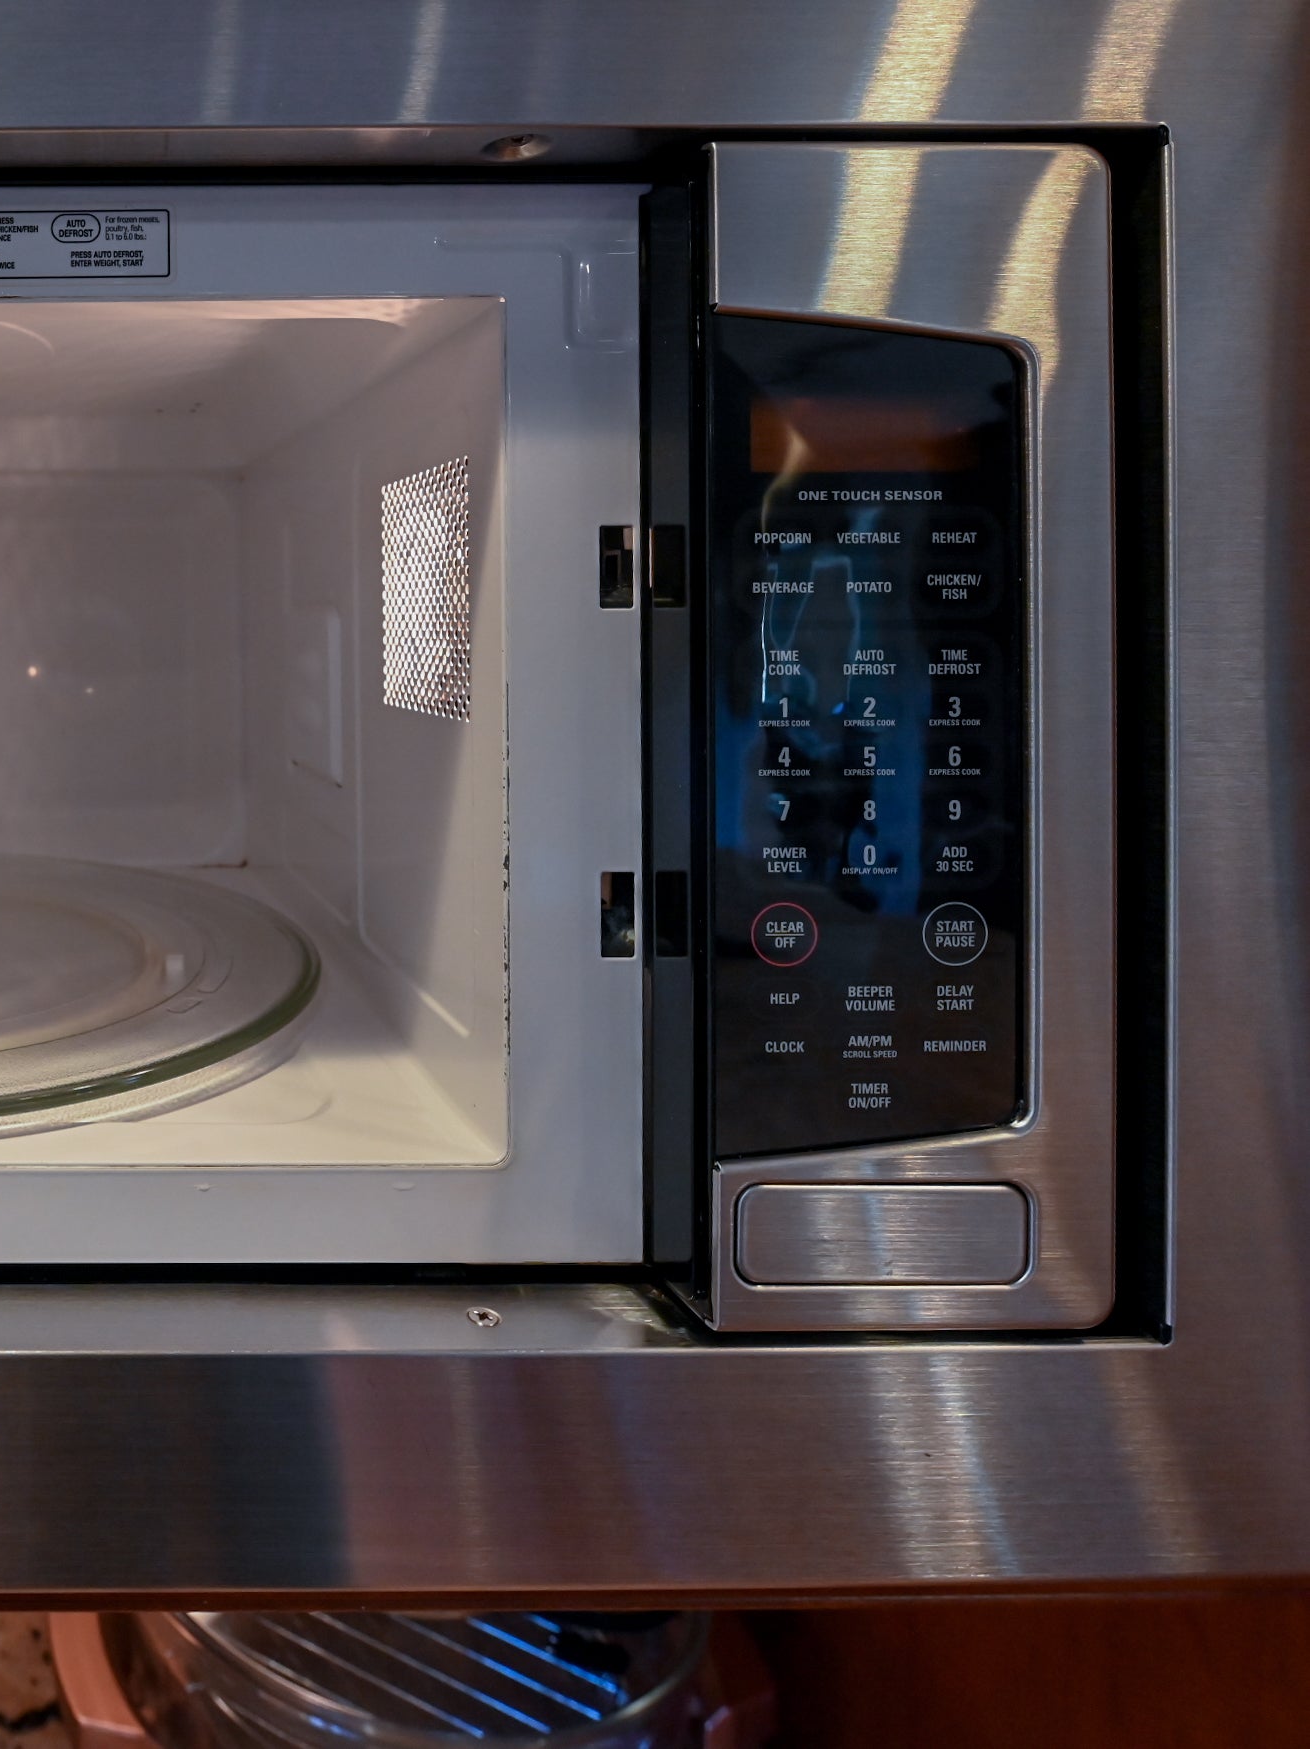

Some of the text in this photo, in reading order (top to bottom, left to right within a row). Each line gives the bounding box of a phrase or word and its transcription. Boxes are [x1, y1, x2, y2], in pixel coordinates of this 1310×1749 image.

[59, 229, 93, 237] DEFROST
[106, 224, 128, 232] poultry,
[113, 250, 144, 258] DEFROST,
[798, 490, 942, 501] ONE TOUCH SENSOR
[754, 533, 811, 544] POPCORN
[837, 533, 900, 544] VEGETABLE
[932, 532, 977, 543] REHEAT
[927, 574, 981, 586] CHICKEN/
[752, 582, 814, 593] BEVERAGE
[846, 582, 891, 593] POTATO
[942, 589, 967, 600] FISH
[770, 651, 799, 661] TIME
[855, 650, 884, 661] AUTO
[941, 650, 967, 660] TIME
[769, 665, 801, 675] COOK
[843, 664, 896, 675] DEFROST
[928, 664, 981, 675] DEFROST
[779, 697, 788, 718] 1
[863, 697, 876, 718] 2
[948, 697, 961, 717] 3
[778, 747, 791, 767] 4
[863, 747, 876, 767] 5
[948, 746, 961, 767] 6
[759, 769, 810, 777] EXPRESS COOK
[778, 801, 790, 821] 7
[863, 800, 876, 820] 8
[948, 800, 961, 820] 9
[763, 848, 807, 858] POWER
[864, 845, 876, 866] 0
[942, 847, 967, 858] ADD
[768, 862, 802, 873] LEVEL
[873, 867, 898, 875] ON/OFF
[936, 861, 973, 872] 30 SEC
[766, 922, 804, 933] CLEAR
[937, 921, 974, 932] START
[775, 937, 795, 948] OFF
[936, 936, 975, 947] PAUSE
[848, 986, 893, 997] BEEPER
[937, 985, 973, 996] DELAY
[770, 993, 800, 1004] HELP
[846, 1000, 895, 1011] VOLUME
[937, 999, 974, 1010] START
[848, 1036, 891, 1047] AM/PM
[924, 1040, 986, 1052] REMINDER
[765, 1042, 804, 1053] CLOCK
[843, 1050, 897, 1058] SCROLL SPEED
[851, 1083, 888, 1094] TIMER
[848, 1097, 891, 1108] ON/OFF
